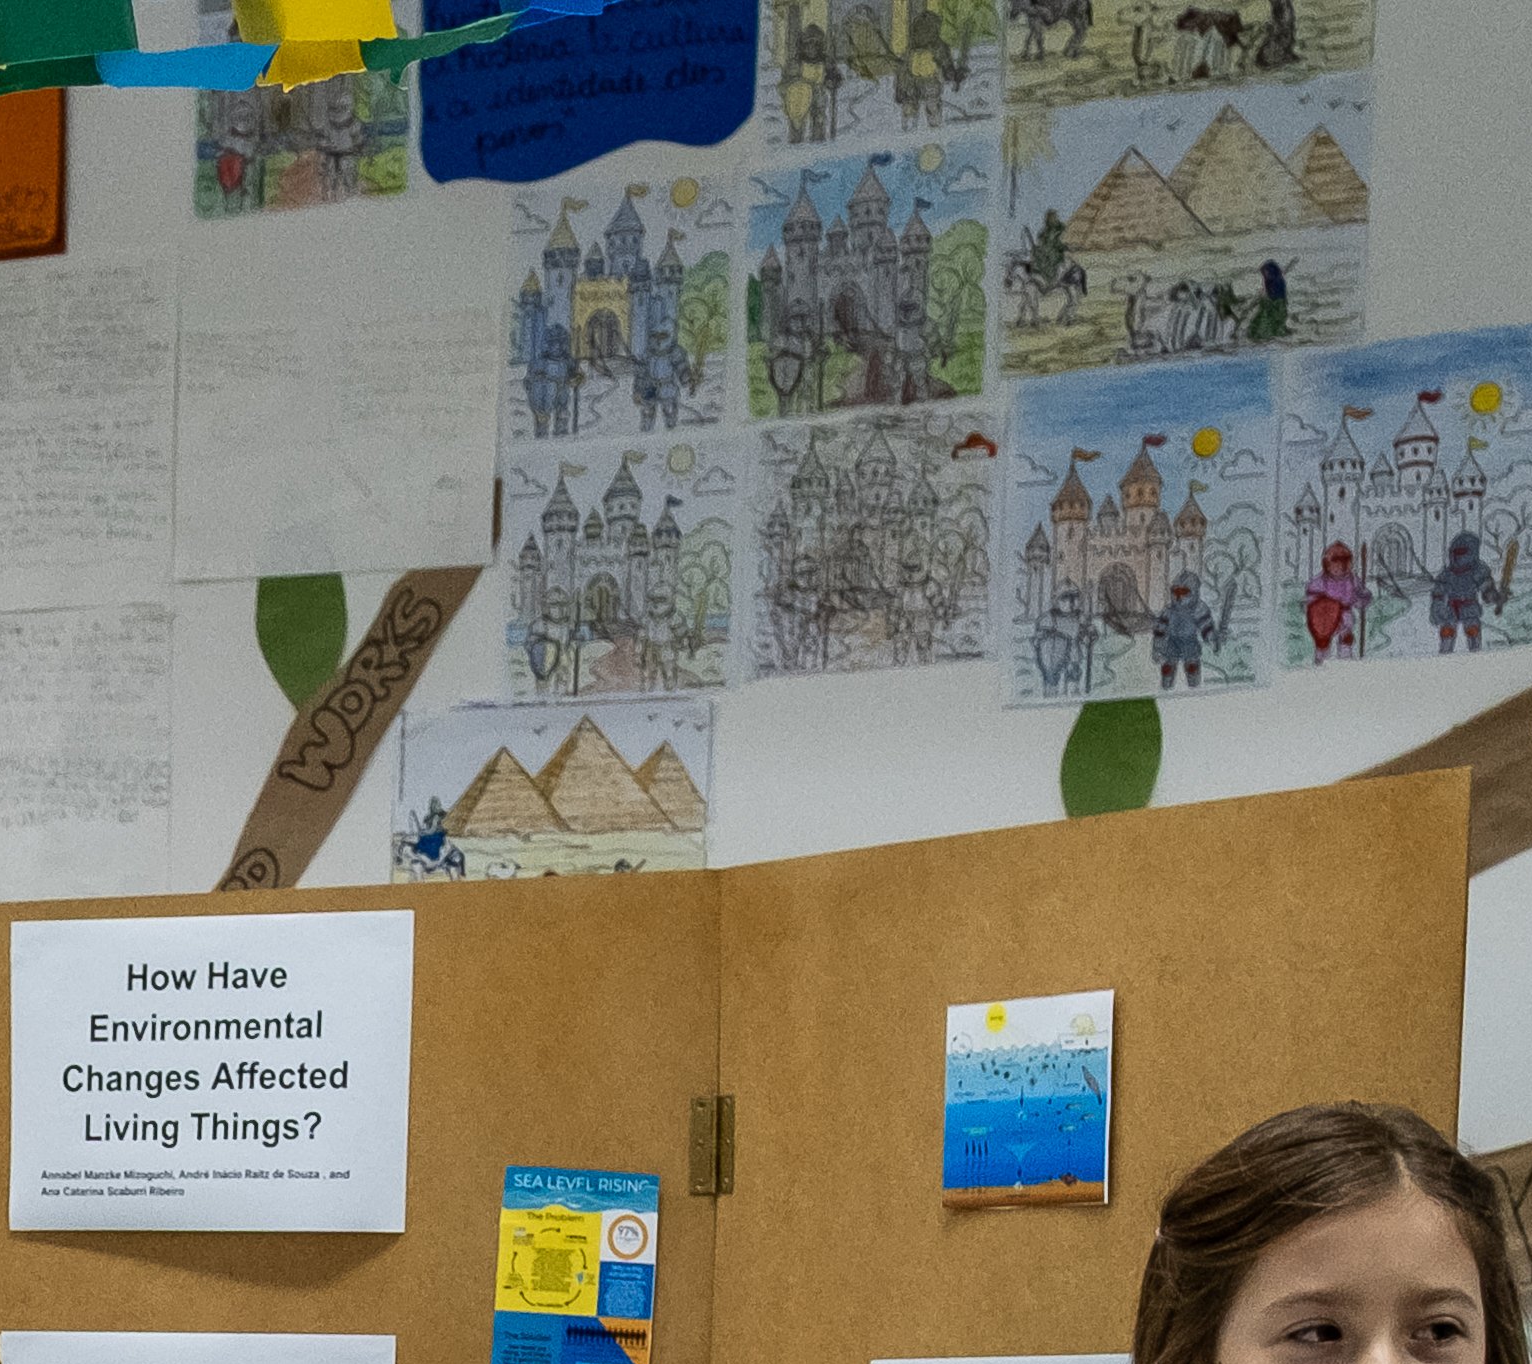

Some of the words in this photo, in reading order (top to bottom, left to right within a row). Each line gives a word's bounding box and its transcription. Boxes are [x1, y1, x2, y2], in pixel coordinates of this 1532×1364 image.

[277, 585, 443, 791] WORKS
[127, 963, 197, 992] How
[208, 961, 288, 990] Have
[90, 1010, 323, 1043] Environmental
[63, 1064, 200, 1099] Changes
[211, 1060, 349, 1090] Affected
[85, 1113, 179, 1149] Living
[191, 1112, 322, 1147] Things?
[272, 1169, 285, 1179] de
[329, 1169, 351, 1180] and
[514, 1173, 543, 1188] SEA
[546, 1175, 594, 1191] LEVEL
